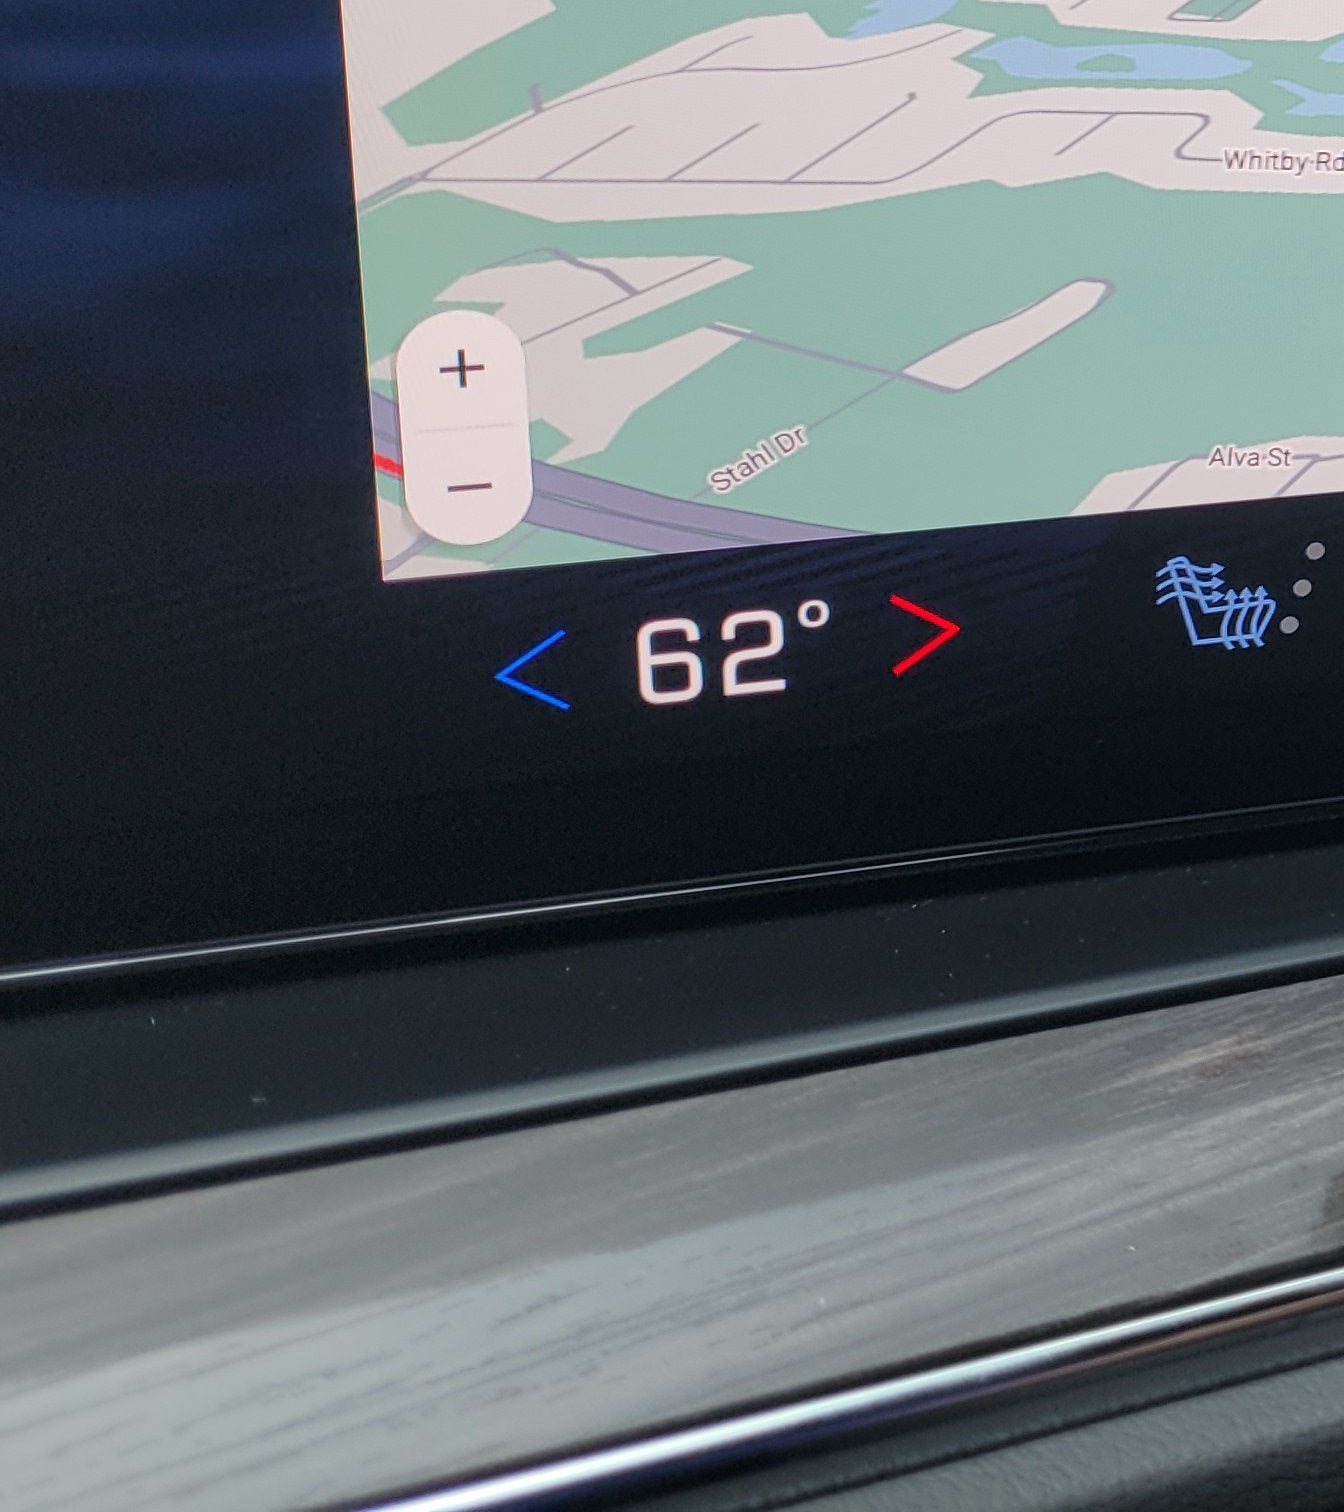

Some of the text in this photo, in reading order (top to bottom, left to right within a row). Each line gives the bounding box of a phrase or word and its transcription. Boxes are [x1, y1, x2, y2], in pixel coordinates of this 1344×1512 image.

[1224, 150, 1309, 176] Whitby
[709, 426, 808, 493] Stahl Dr
[1209, 448, 1291, 466] Alva St
[636, 599, 830, 707] 62°
